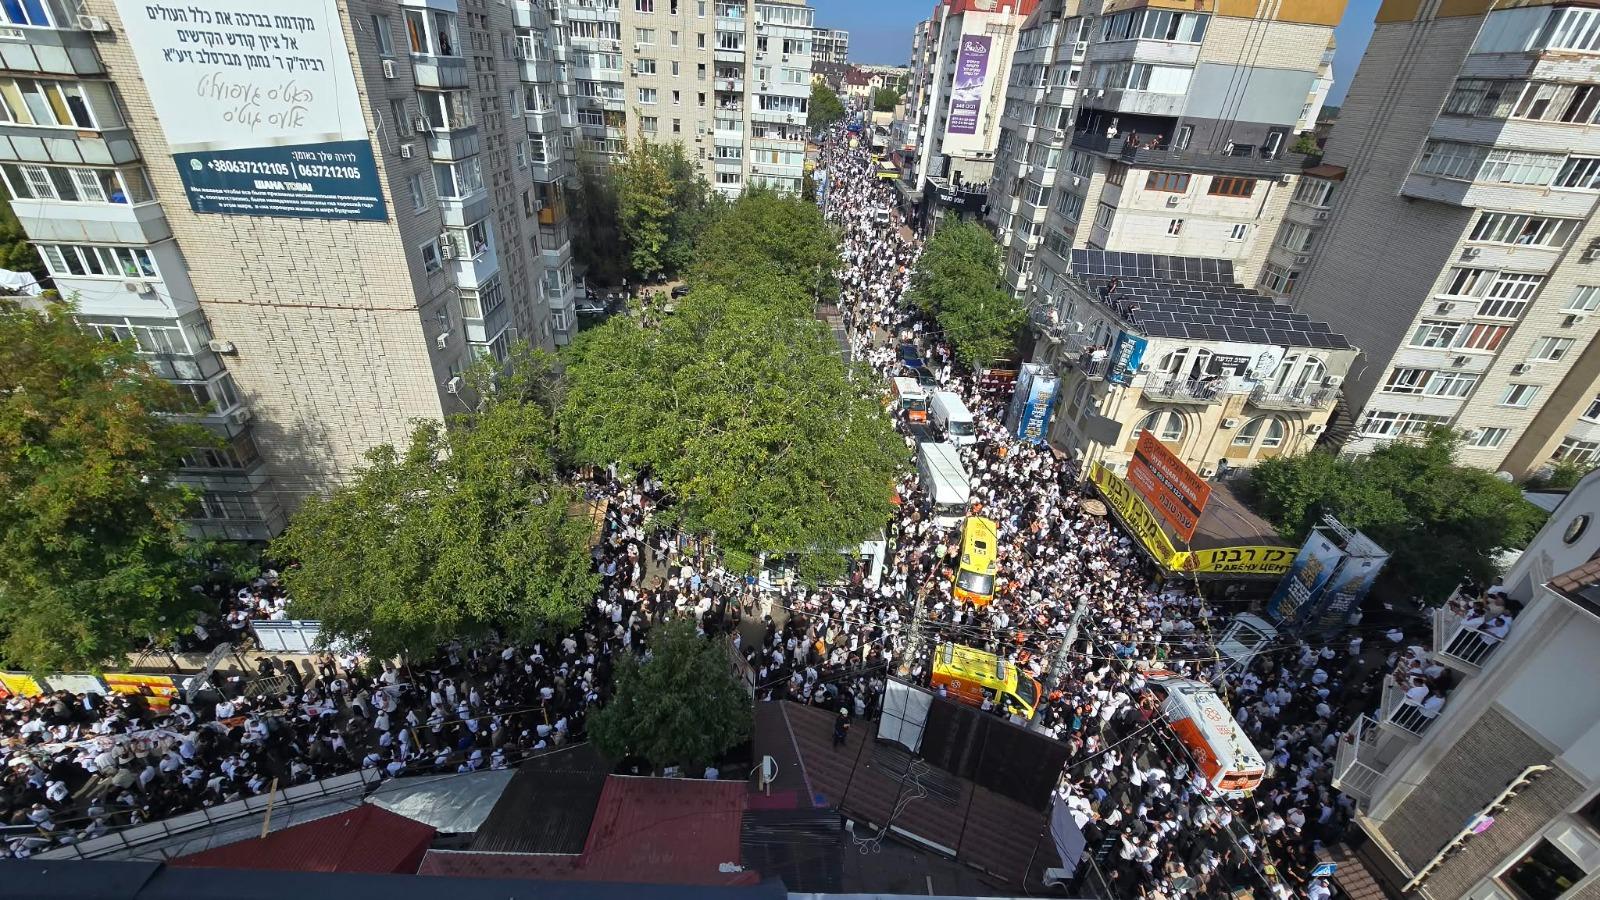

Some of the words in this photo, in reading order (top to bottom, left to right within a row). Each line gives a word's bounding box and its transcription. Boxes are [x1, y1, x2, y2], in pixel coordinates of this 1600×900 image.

[146, 4, 188, 22] העולים
[188, 6, 212, 23] כלל
[216, 11, 232, 26] את
[235, 12, 272, 28] בברכה
[275, 15, 315, 34] מקדמת
[177, 30, 224, 48] הקדשים
[226, 32, 256, 48] קודש
[258, 35, 280, 51] ציון
[281, 34, 298, 50] אל
[196, 49, 242, 67] מברסלב
[244, 54, 270, 70] נחמן
[317, 151, 332, 162] שלך
[335, 153, 356, 162] לדירה
[208, 160, 289, 175] +380637212105
[299, 165, 360, 179] 0637212105
[254, 180, 285, 190] ШАНА
[1108, 474, 1130, 502] רבנו
[1160, 494, 1176, 512] טובה
[1211, 549, 1256, 563] רבנו
